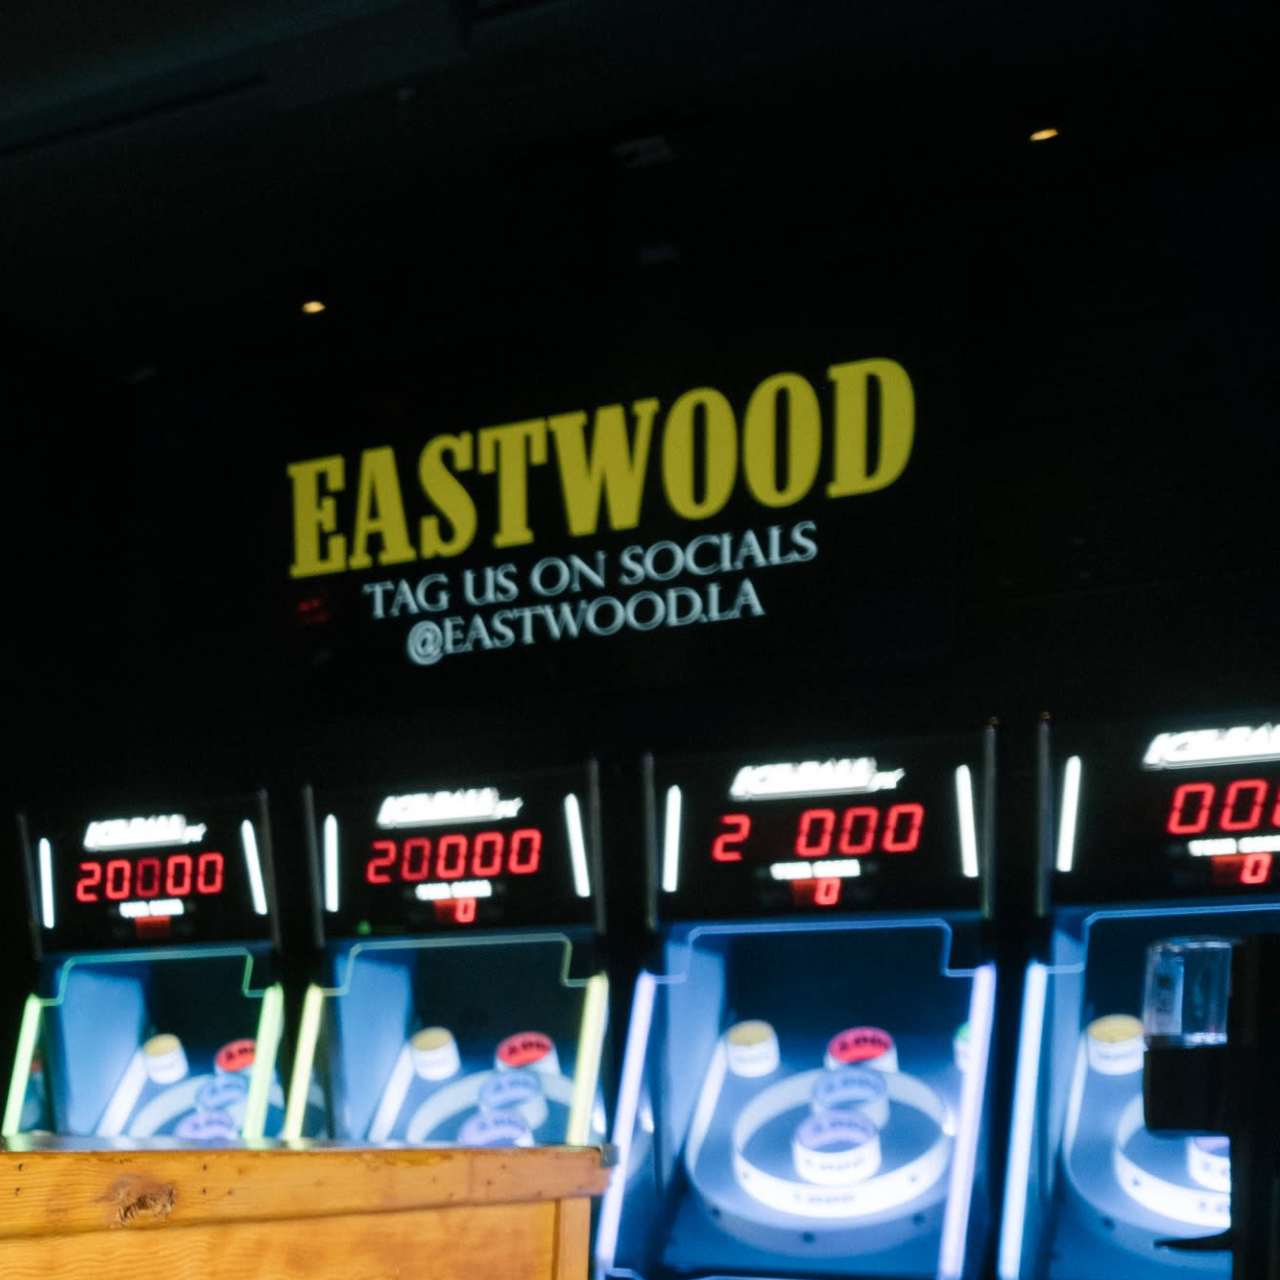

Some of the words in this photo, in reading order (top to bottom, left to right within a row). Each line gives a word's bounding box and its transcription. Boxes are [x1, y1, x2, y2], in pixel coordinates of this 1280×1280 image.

[288, 358, 915, 577] EASTWOOD
[363, 573, 449, 619] TAG
[464, 563, 519, 606] US
[530, 550, 608, 596] ON
[620, 520, 818, 582] SOCIALS
[406, 578, 766, 665] @EASTWOOD.LA
[1166, 778, 1280, 836] 00
[74, 851, 224, 902] 20000
[366, 828, 542, 884] 20000
